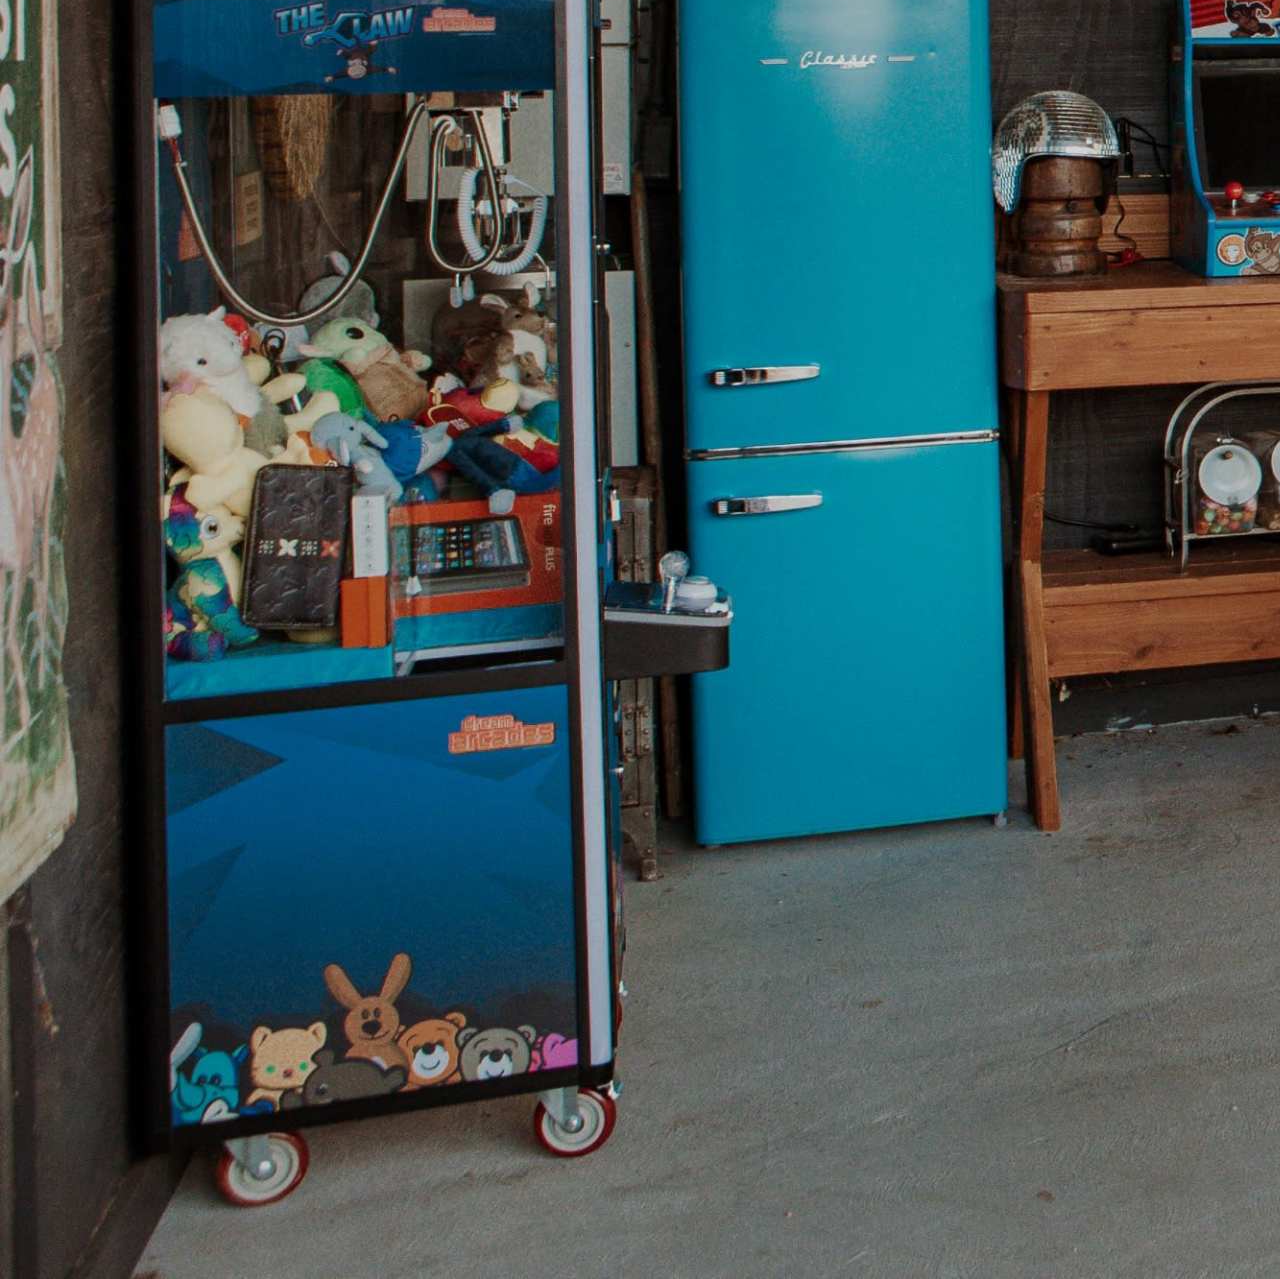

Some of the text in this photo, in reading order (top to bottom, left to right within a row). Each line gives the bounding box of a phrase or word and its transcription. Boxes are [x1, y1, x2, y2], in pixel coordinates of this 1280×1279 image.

[275, 3, 325, 34] THE
[800, 51, 879, 69] Classic
[543, 504, 557, 526] fire
[545, 546, 556, 571] PLUS
